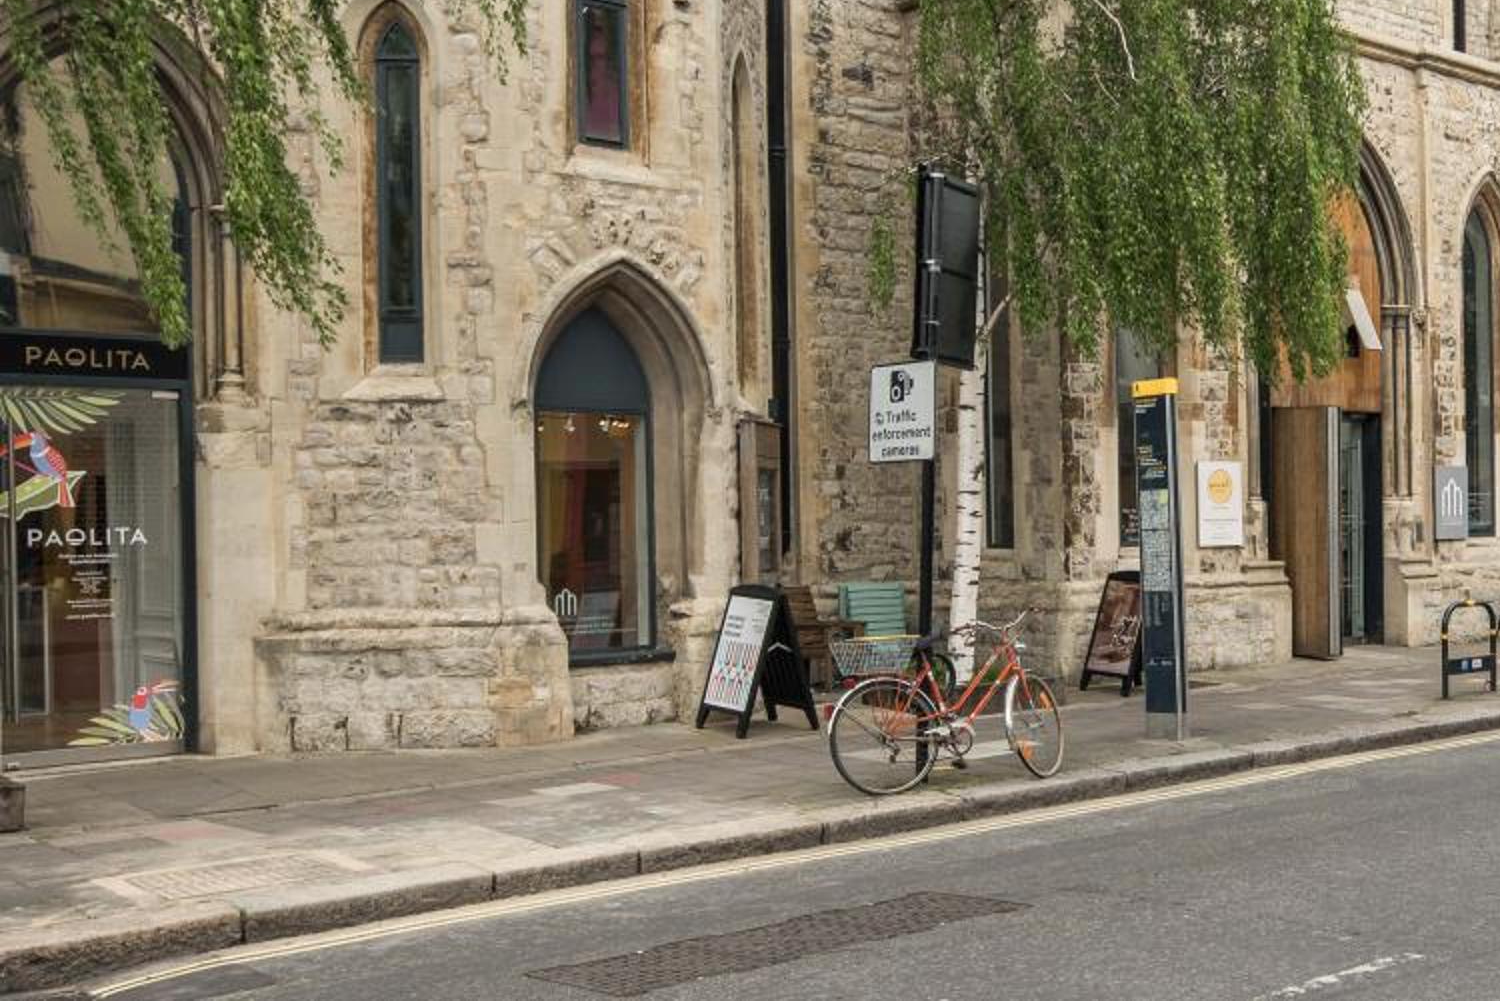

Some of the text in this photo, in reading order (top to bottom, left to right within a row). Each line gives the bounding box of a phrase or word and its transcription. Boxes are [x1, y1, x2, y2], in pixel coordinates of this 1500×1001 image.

[24, 345, 150, 371] PAOLITA
[886, 409, 917, 423] Traffic
[872, 426, 931, 442] enforcement
[881, 445, 919, 457] cameras
[26, 527, 148, 548] PAOLITA
